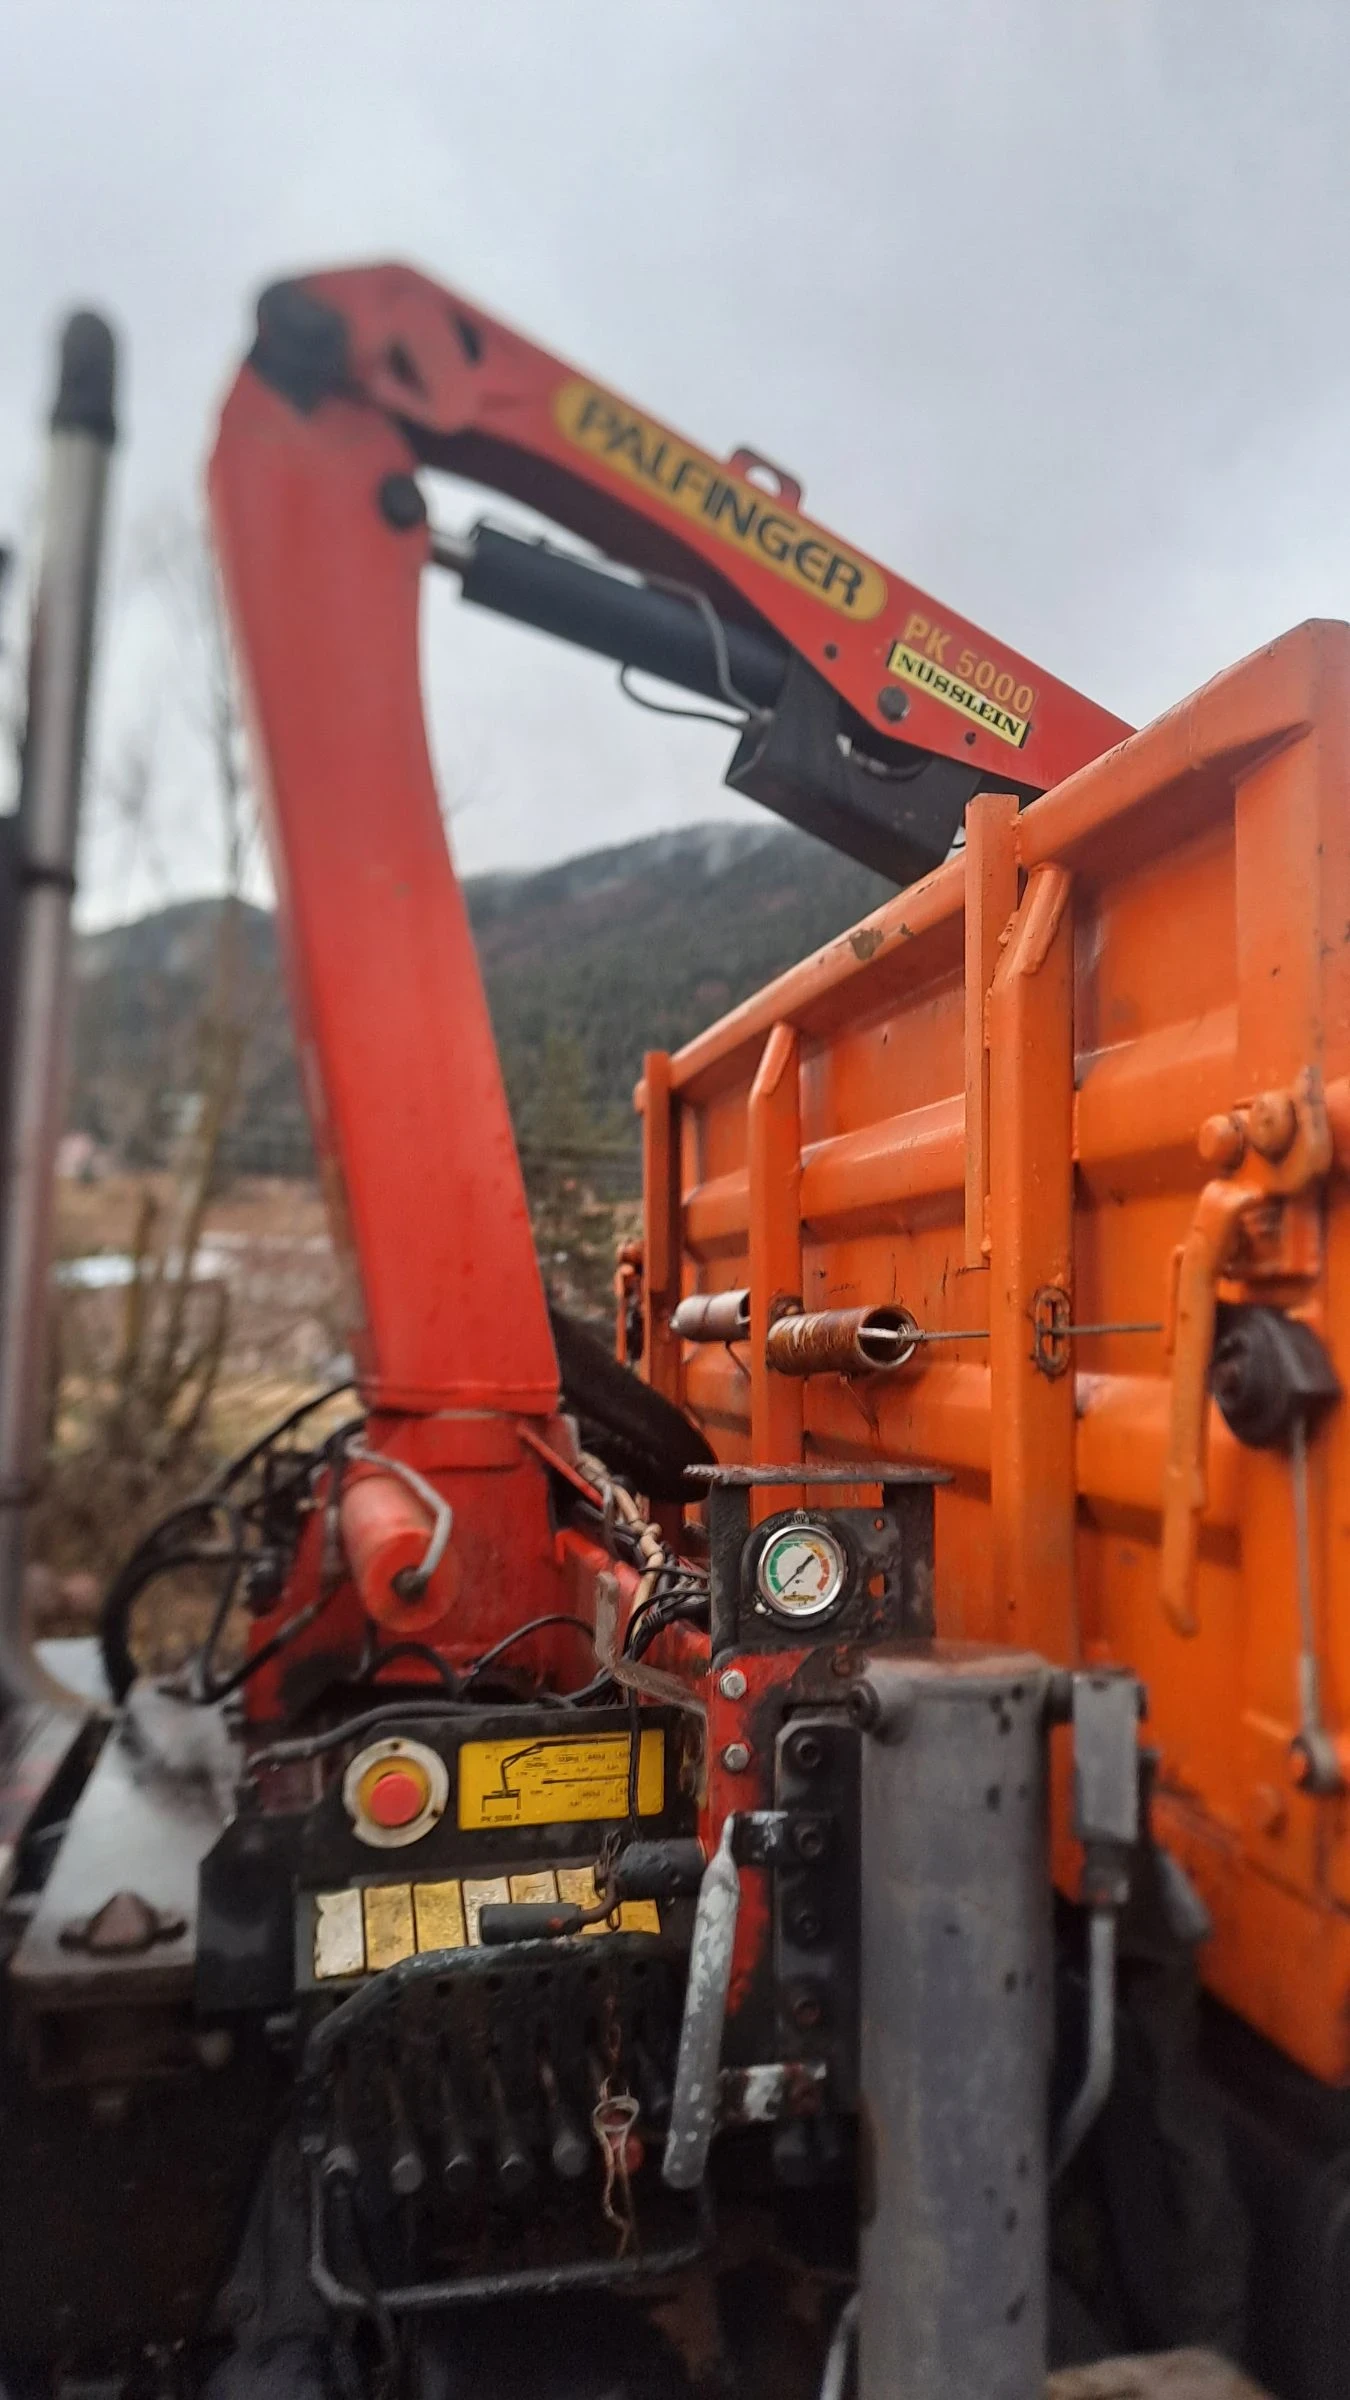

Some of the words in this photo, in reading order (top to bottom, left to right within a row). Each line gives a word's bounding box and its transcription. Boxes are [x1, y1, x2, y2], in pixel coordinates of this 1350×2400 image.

[576, 394, 864, 606] PALFINGER
[904, 614, 951, 664] PK
[956, 649, 1034, 714] 5000
